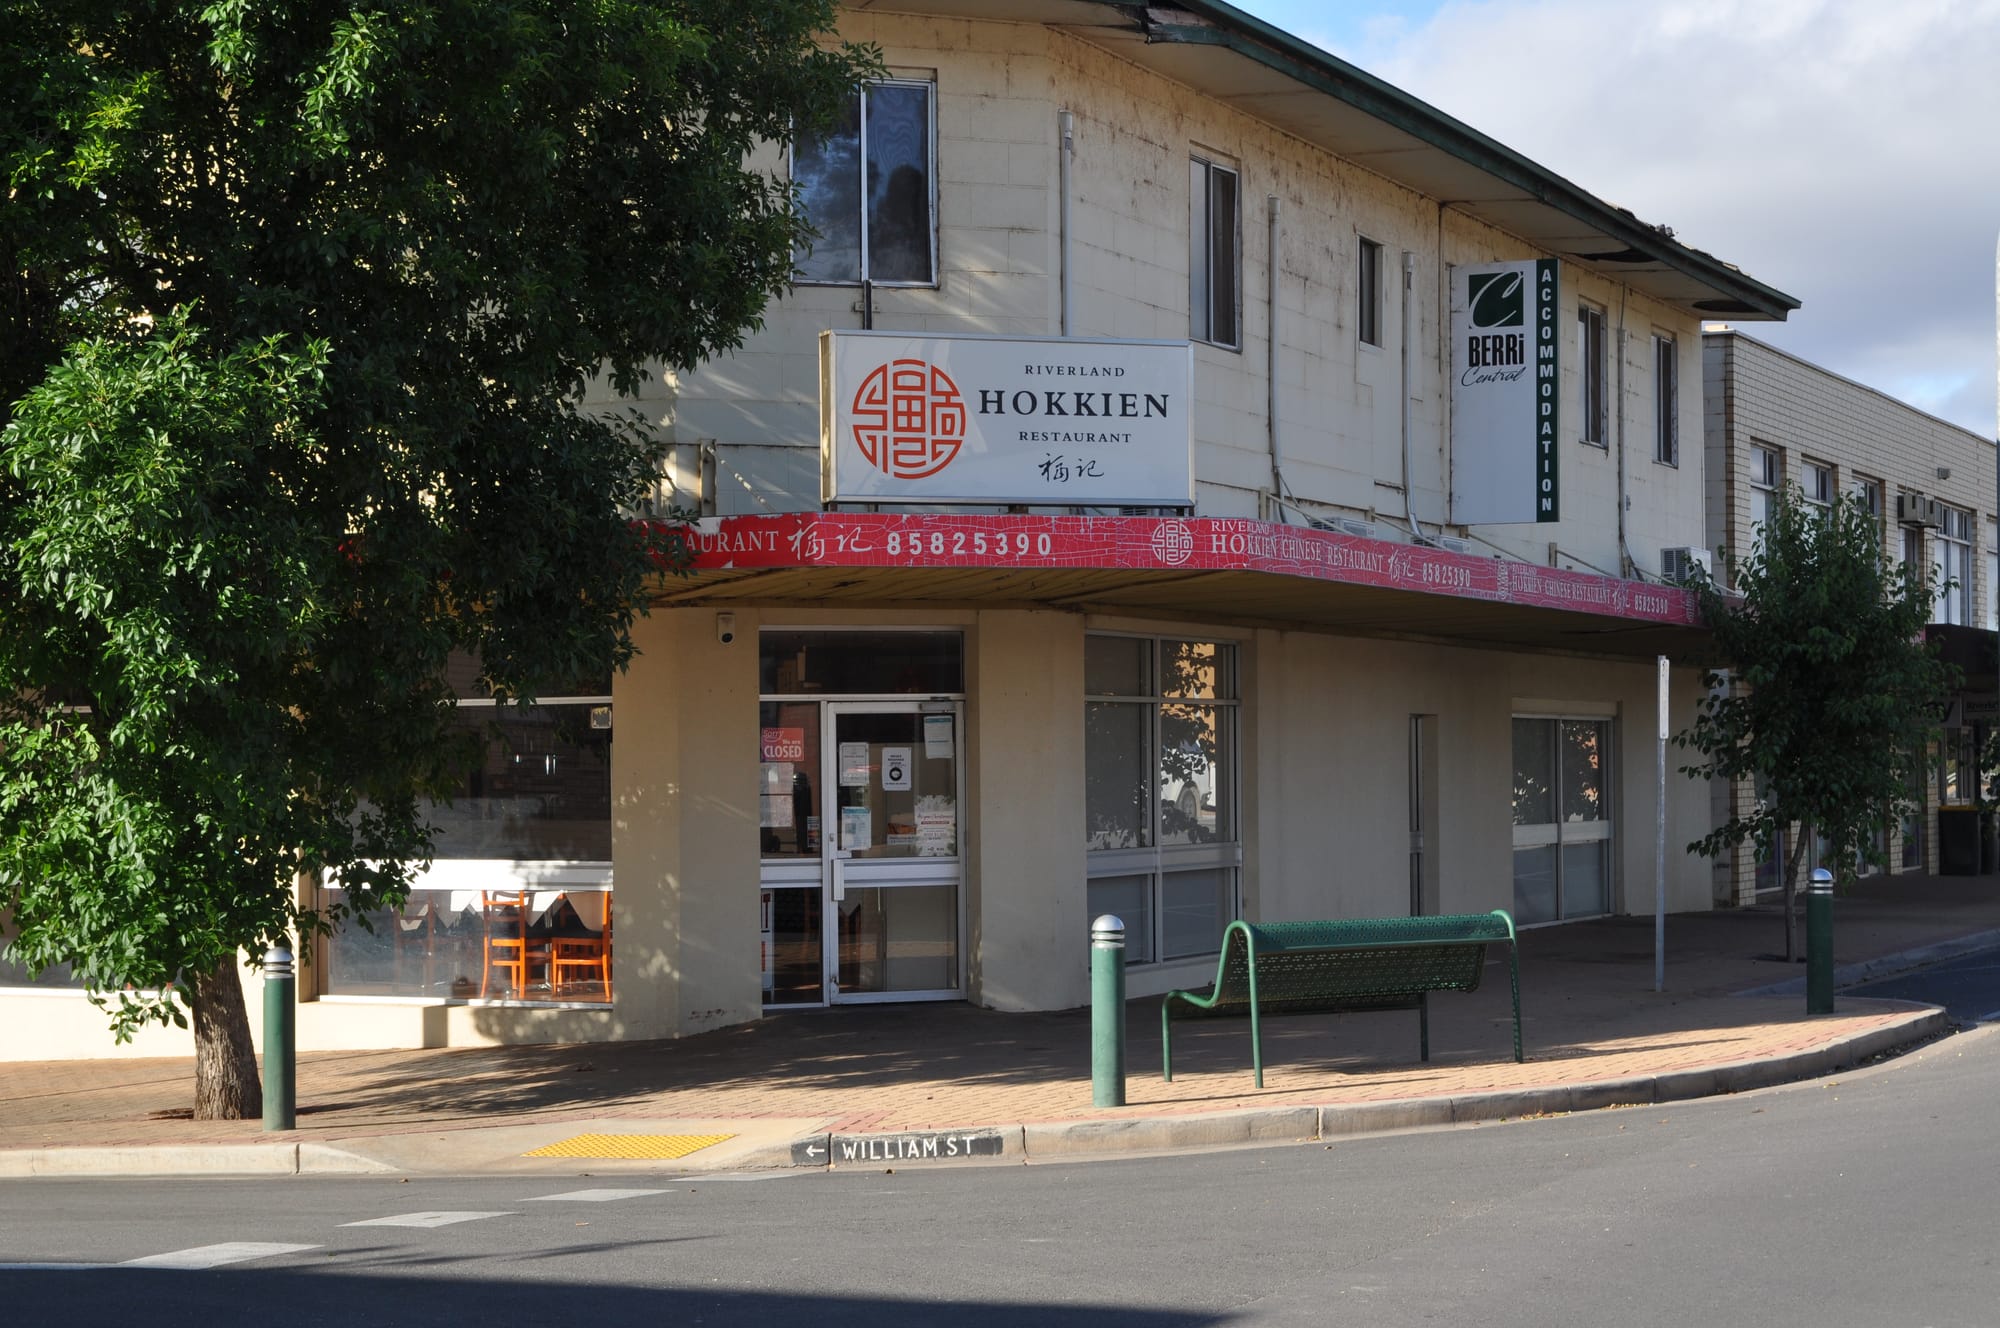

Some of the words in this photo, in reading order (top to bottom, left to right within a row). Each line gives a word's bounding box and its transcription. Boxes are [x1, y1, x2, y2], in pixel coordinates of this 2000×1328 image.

[1024, 364, 1125, 378] RIVERLAND
[1461, 366, 1527, 387] Central
[1539, 268, 1554, 512] ACCOMMODATION
[978, 389, 1170, 418] HOKKIEN
[1018, 431, 1132, 443] RESTAURANT
[1211, 519, 1270, 535] RIVERLAND
[887, 531, 1052, 555] 85825390
[1211, 533, 1278, 558] HOKKIEN
[1282, 538, 1323, 562] CHINESE
[1327, 546, 1384, 573] RESTAURANT
[1422, 562, 1471, 587] 85825390
[1512, 575, 1542, 594] HOKKIEN
[1544, 579, 1571, 600] CHINESE
[1571, 583, 1611, 605] RESTAURANT
[1634, 594, 1669, 615] 85825390
[764, 745, 802, 758] CLOSED
[842, 1137, 938, 1160] WILLIAM
[946, 1136, 976, 1156] ST
